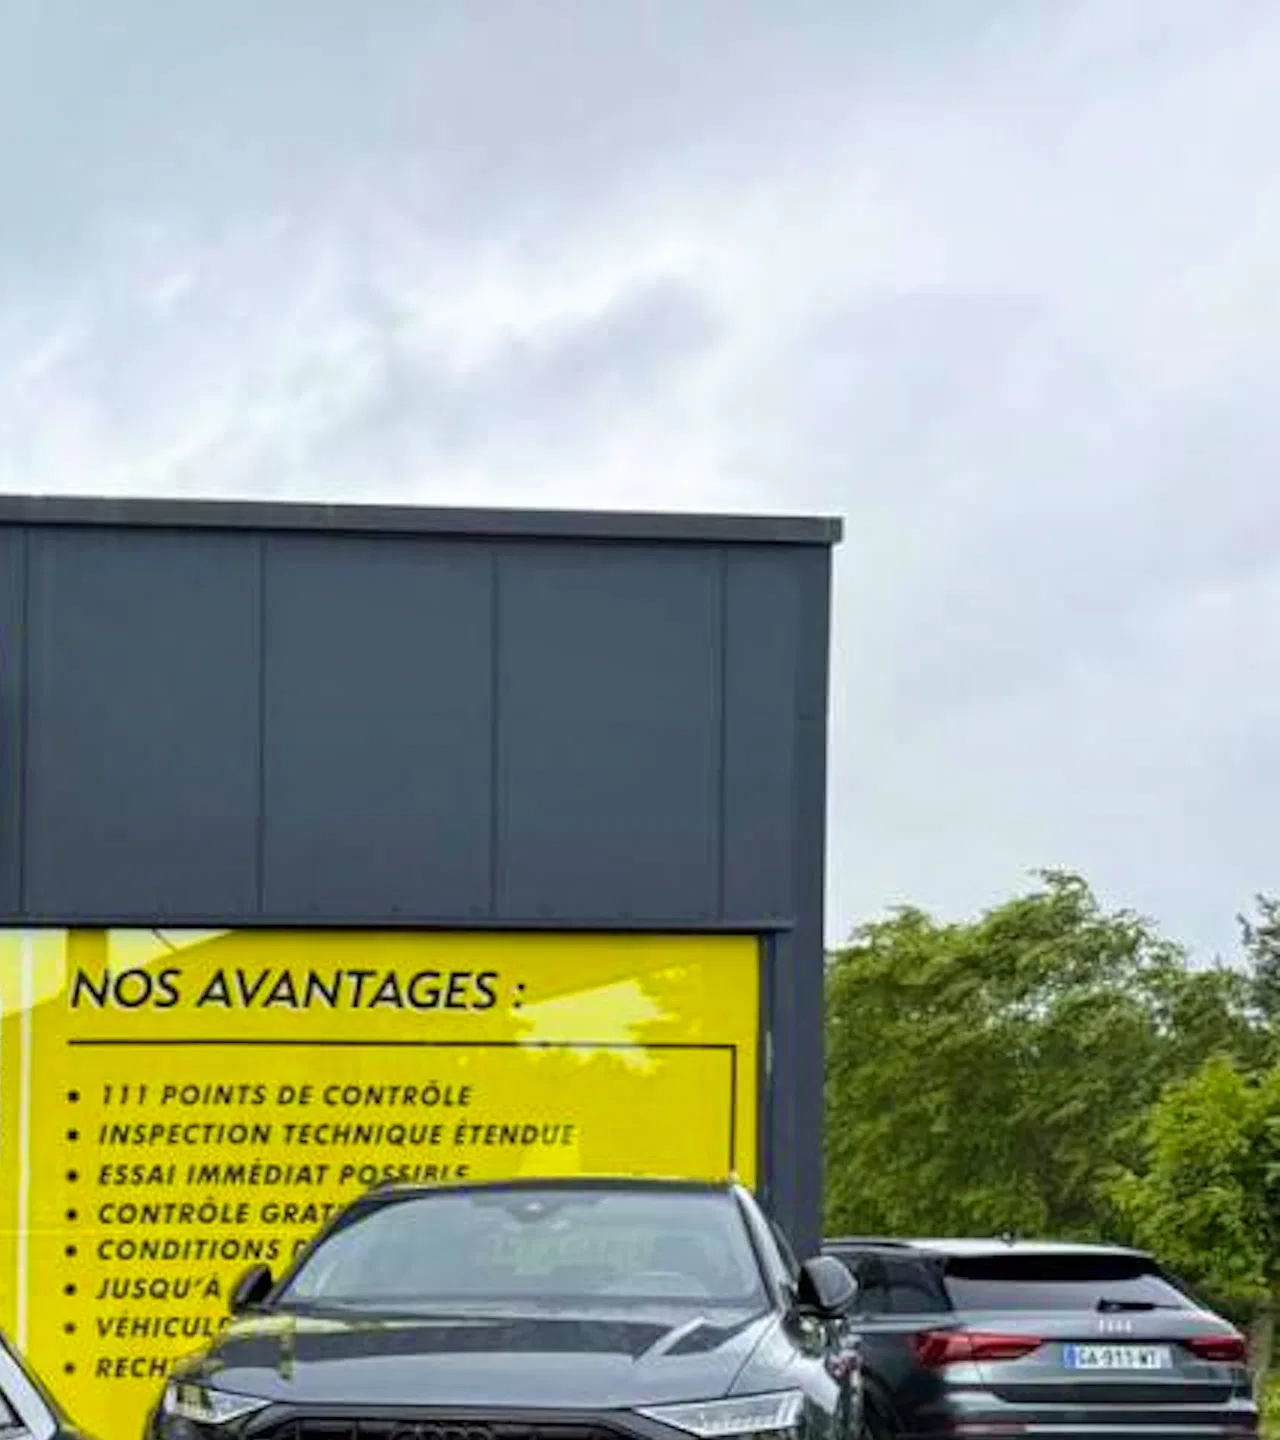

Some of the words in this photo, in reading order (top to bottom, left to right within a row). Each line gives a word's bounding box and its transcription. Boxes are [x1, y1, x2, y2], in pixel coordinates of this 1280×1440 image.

[70, 968, 181, 1009] NOS
[197, 968, 499, 1009] AVANTAGES
[103, 1083, 148, 1106] 111
[161, 1083, 268, 1106] POINTS
[277, 1084, 315, 1106] DE
[323, 1079, 474, 1107] CONTRÔLE
[99, 1124, 271, 1145] INSPECTION
[283, 1123, 442, 1146] TECHNIQUE
[453, 1116, 577, 1146] ÉTENDUE
[98, 1164, 177, 1187] ESSAI
[186, 1156, 331, 1187] IMMÉDIAT
[98, 1196, 249, 1225] CONTRÔLE
[260, 1202, 344, 1225] GRAT
[96, 1238, 281, 1261] CONDITIONS
[94, 1356, 176, 1378] RECH
